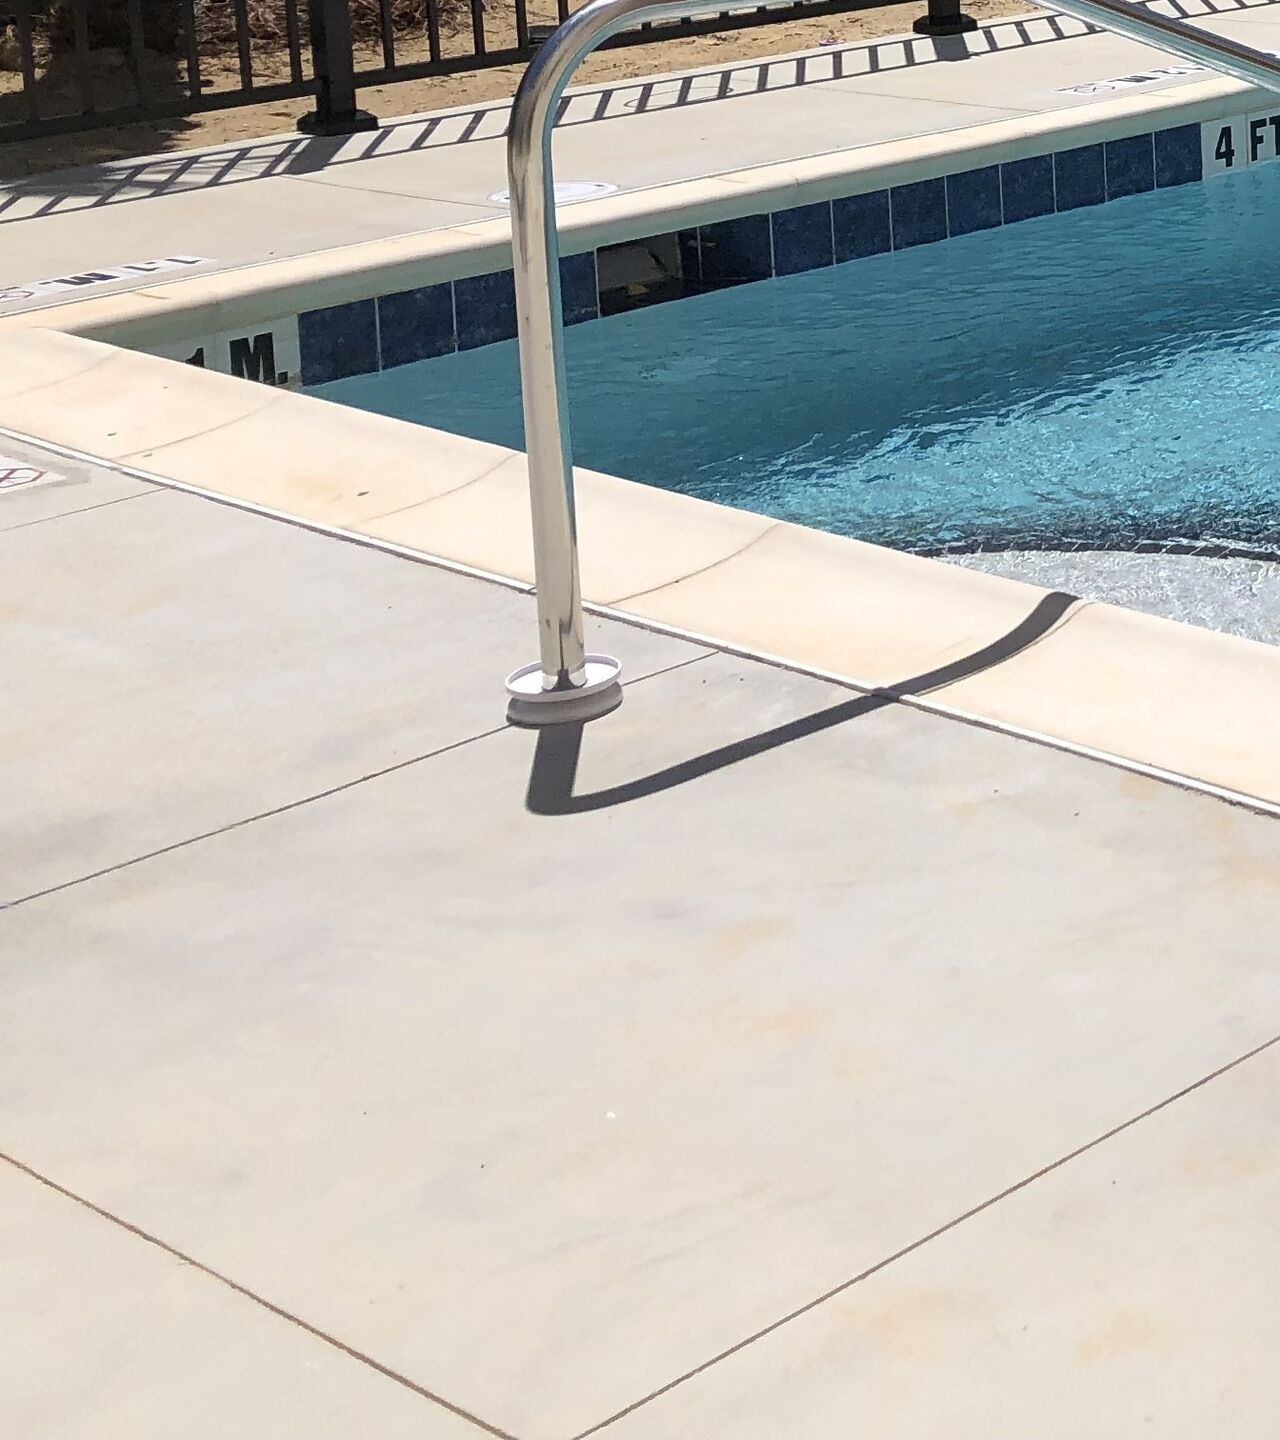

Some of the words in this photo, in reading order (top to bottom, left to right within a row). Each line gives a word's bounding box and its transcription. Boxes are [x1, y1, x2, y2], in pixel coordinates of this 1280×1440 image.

[1215, 125, 1236, 168] 4
[39, 272, 120, 286] M.
[229, 331, 289, 385] M.
